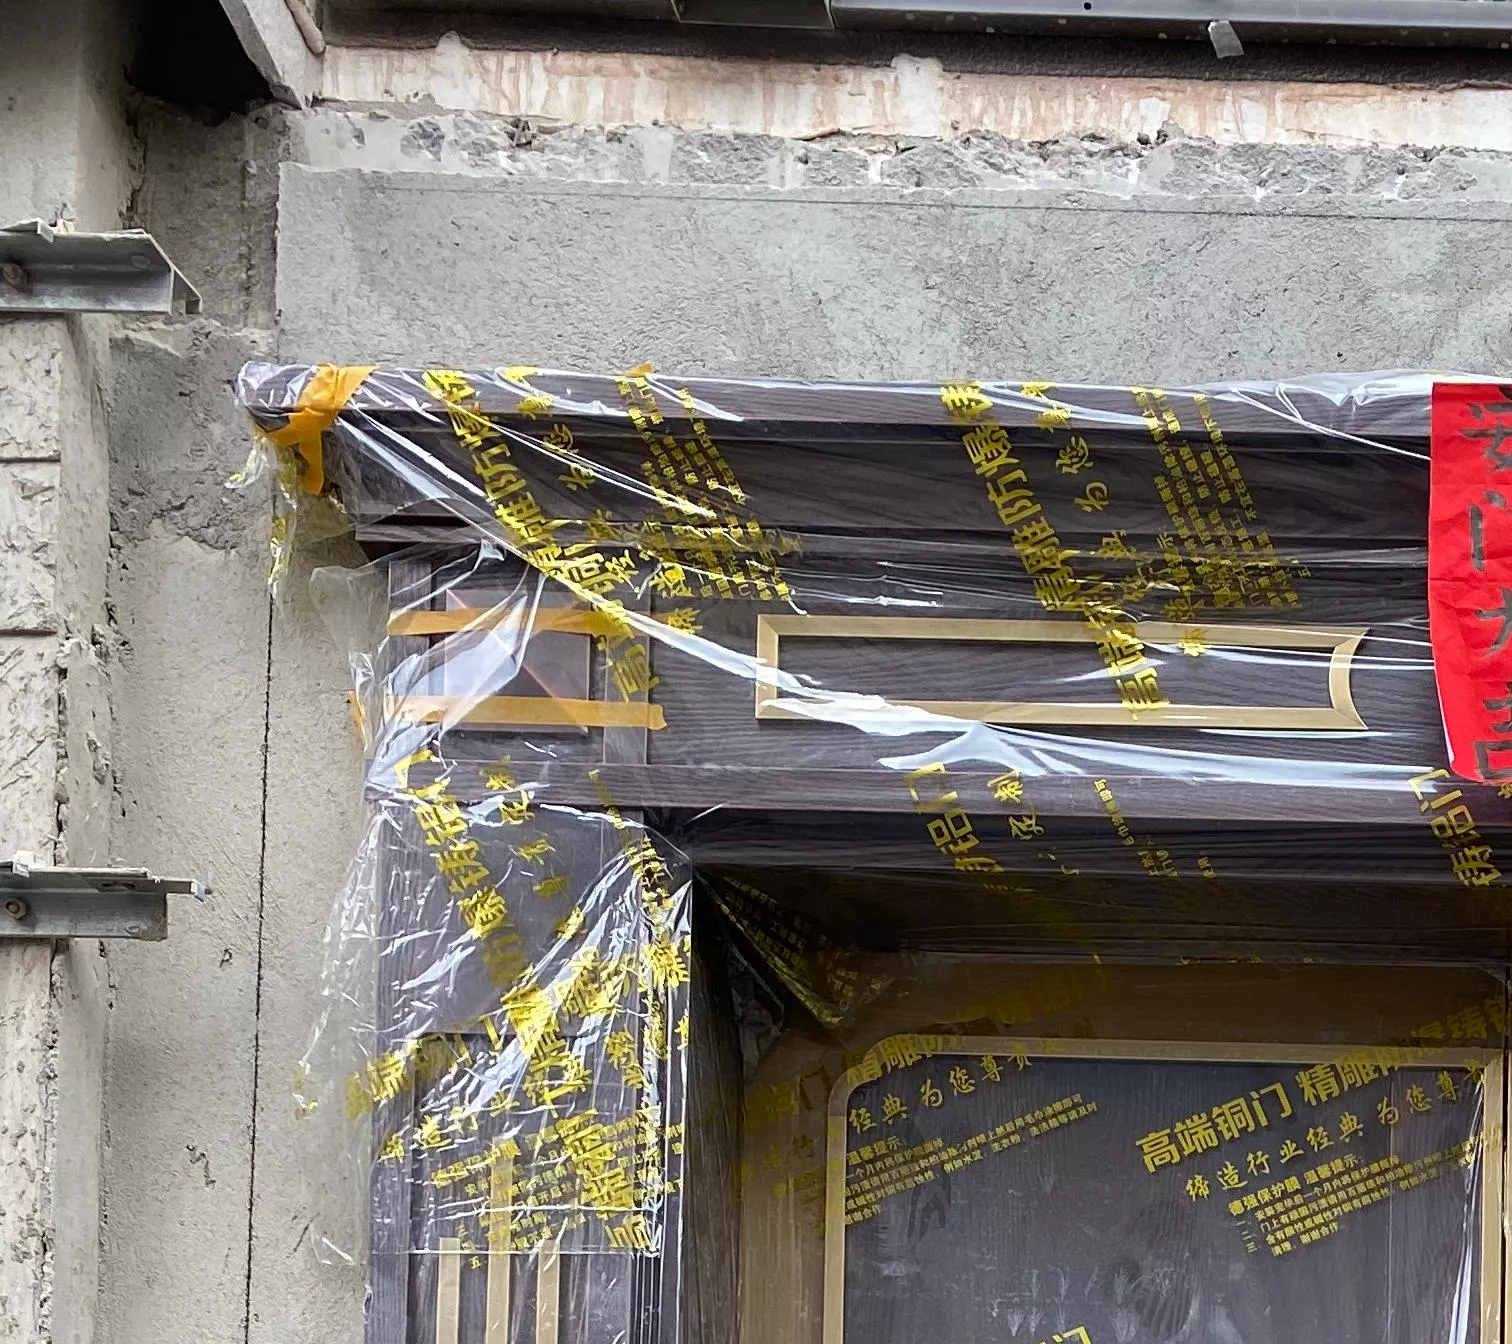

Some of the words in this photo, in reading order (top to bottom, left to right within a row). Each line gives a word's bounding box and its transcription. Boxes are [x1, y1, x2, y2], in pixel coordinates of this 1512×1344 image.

[1135, 1081, 1294, 1173] 高端铜门
[1184, 1112, 1365, 1202] 缔造行业经典
